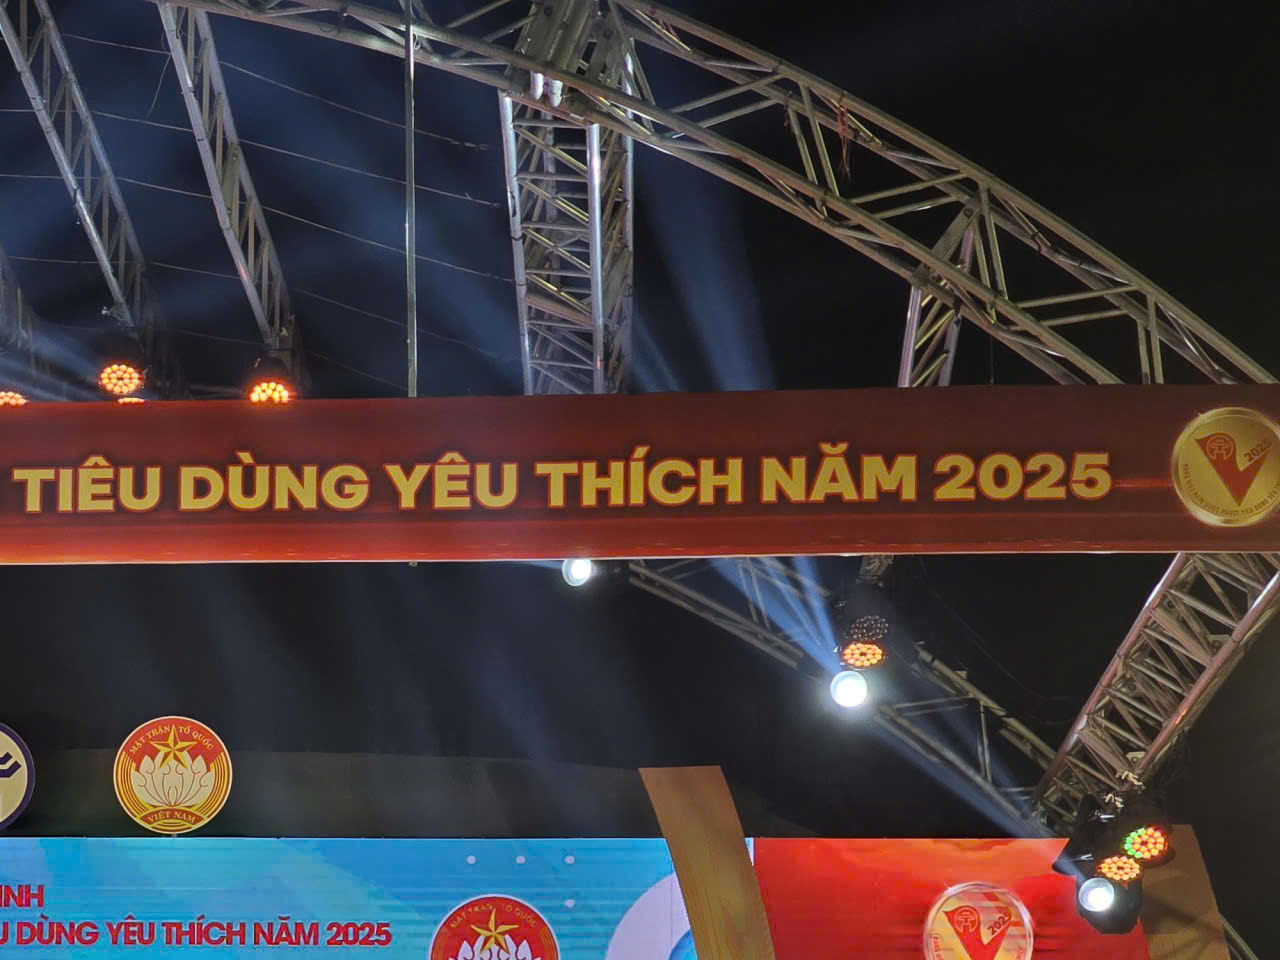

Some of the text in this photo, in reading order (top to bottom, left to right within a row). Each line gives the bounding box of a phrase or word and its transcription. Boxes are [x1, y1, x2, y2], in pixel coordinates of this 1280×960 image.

[11, 457, 160, 513] TIÊU
[180, 452, 371, 511] DÙNG
[384, 452, 517, 510] YÊU
[535, 445, 742, 509] THÍCH
[761, 442, 917, 504] NĂM
[933, 452, 1111, 502] 2025
[174, 811, 196, 824] NAM
[19, 913, 99, 945] DÙNG
[108, 913, 155, 945] YÊU
[161, 913, 246, 945] THÍCH
[253, 914, 319, 945] NĂM
[326, 921, 392, 946] 2025
